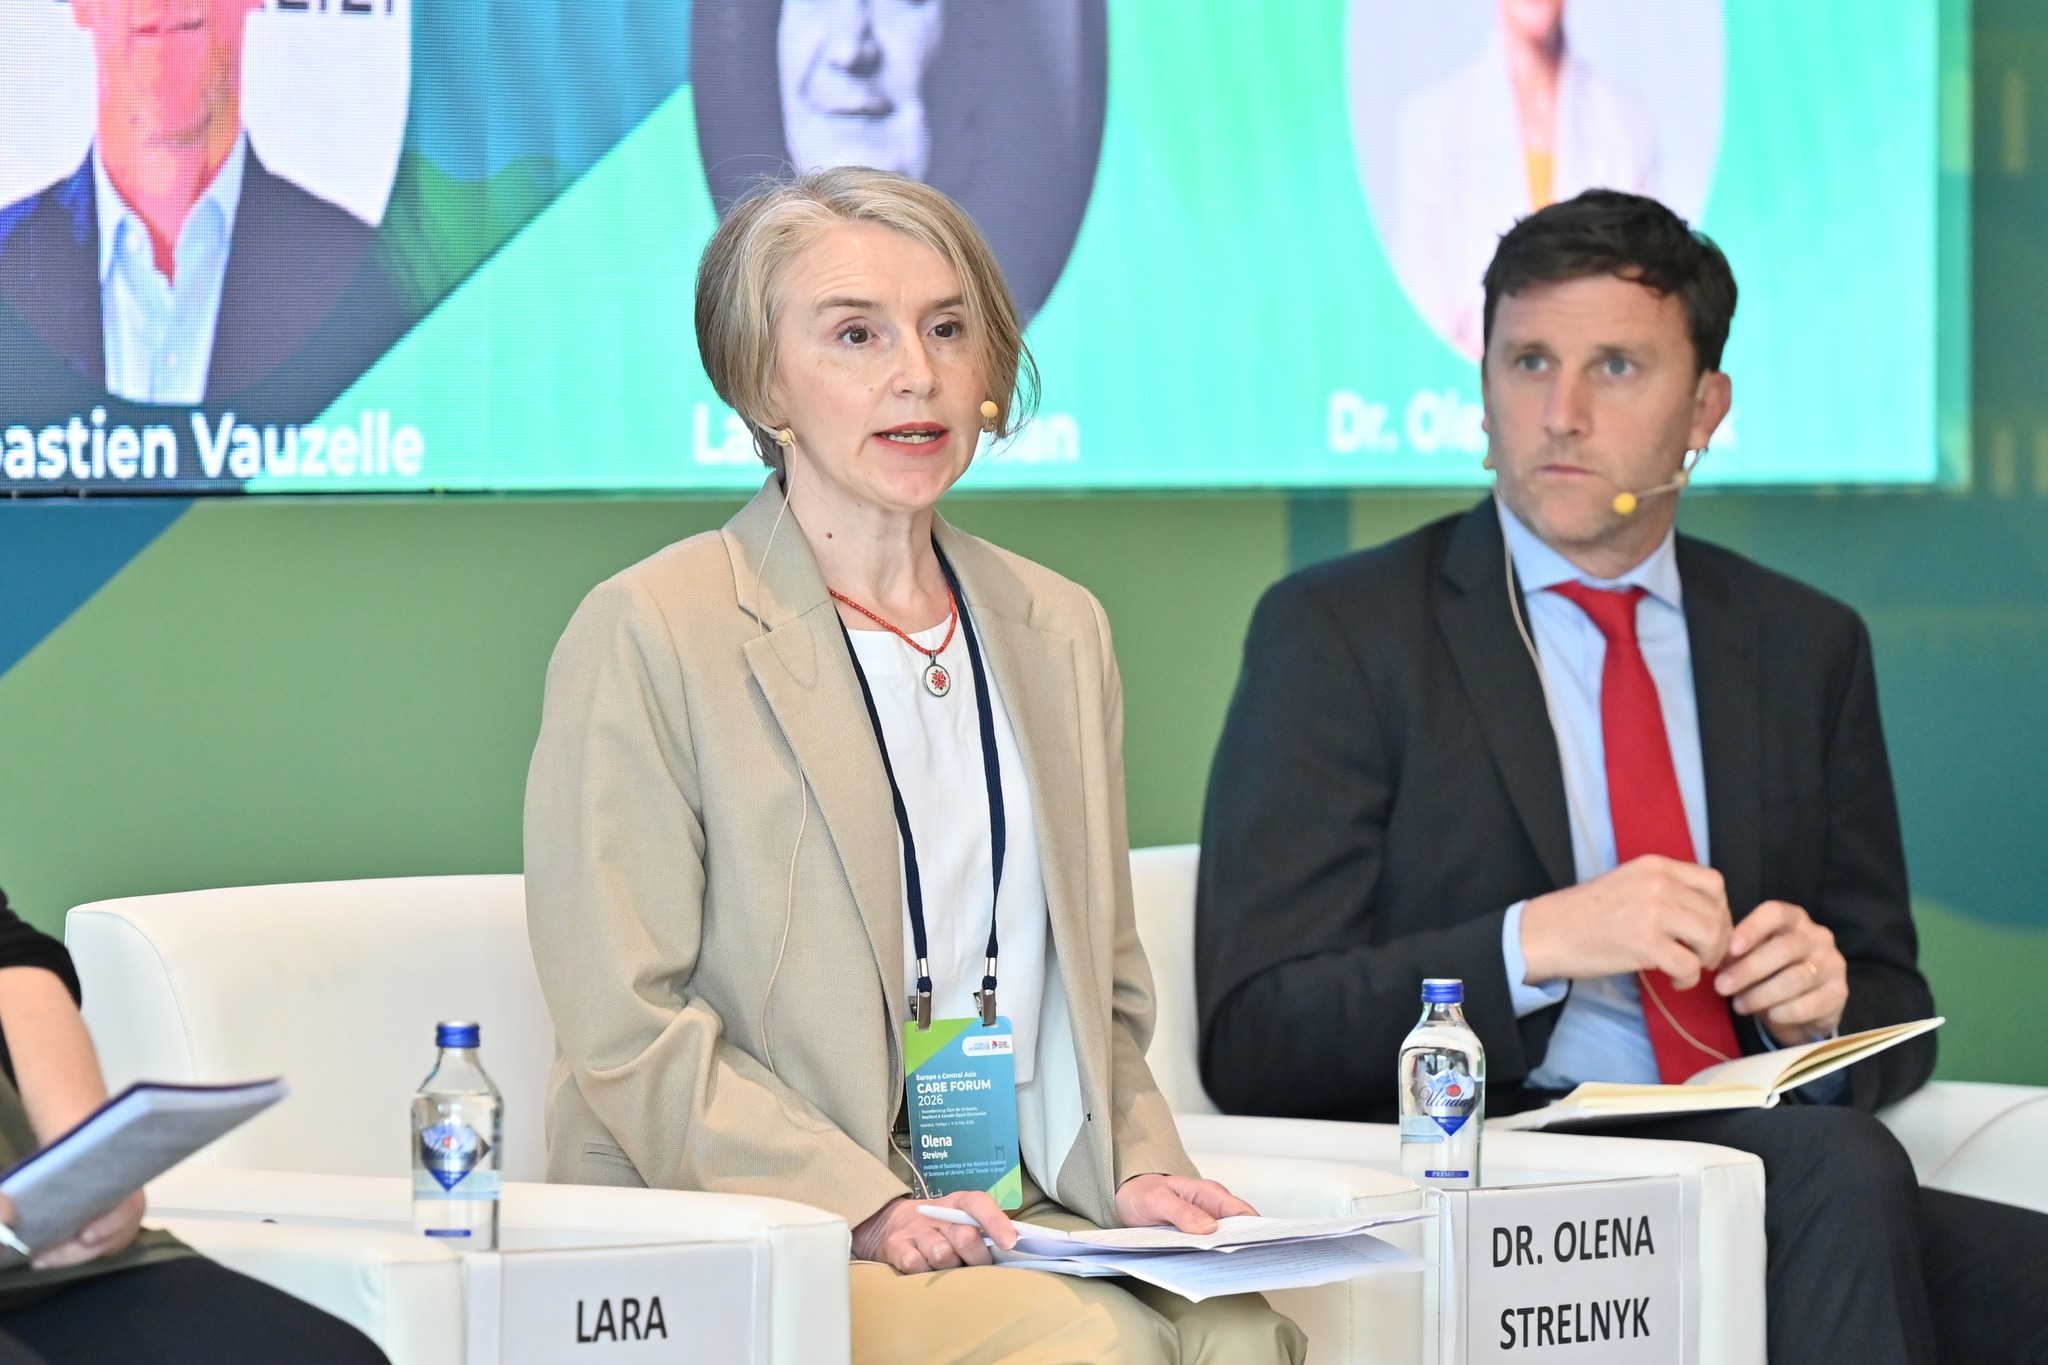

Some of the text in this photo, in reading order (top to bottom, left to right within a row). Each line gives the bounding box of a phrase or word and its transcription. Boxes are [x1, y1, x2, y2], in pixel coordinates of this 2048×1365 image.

[0, 405, 425, 479] astien Vauzelle
[1404, 387, 1489, 453] Ole
[917, 1079, 991, 1094] CARE FORUM
[918, 1095, 943, 1106] 2026
[921, 1134, 952, 1148] Olena
[922, 1150, 949, 1160] Strelnyk
[1492, 1215, 1655, 1268] DR. OLENA
[576, 1296, 667, 1343] LARA
[1500, 1297, 1650, 1350] STRELNYK
